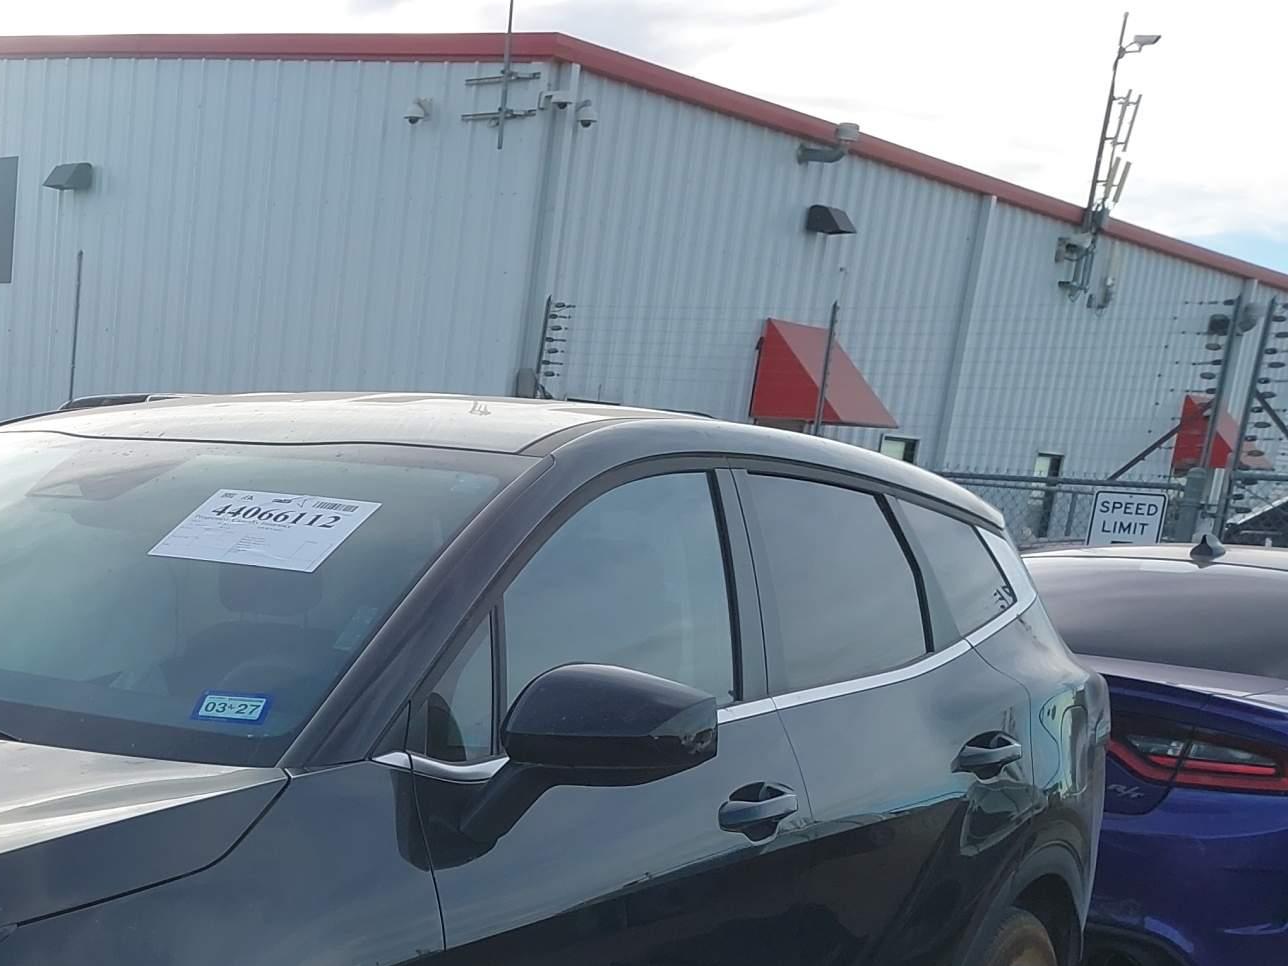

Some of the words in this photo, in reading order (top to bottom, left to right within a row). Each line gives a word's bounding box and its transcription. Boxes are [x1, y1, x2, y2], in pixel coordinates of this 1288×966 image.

[211, 503, 341, 529] 44066112
[1099, 500, 1159, 517] SPEED
[1101, 520, 1149, 536] LIMIT
[204, 701, 228, 714] 03
[234, 703, 262, 715] 27
